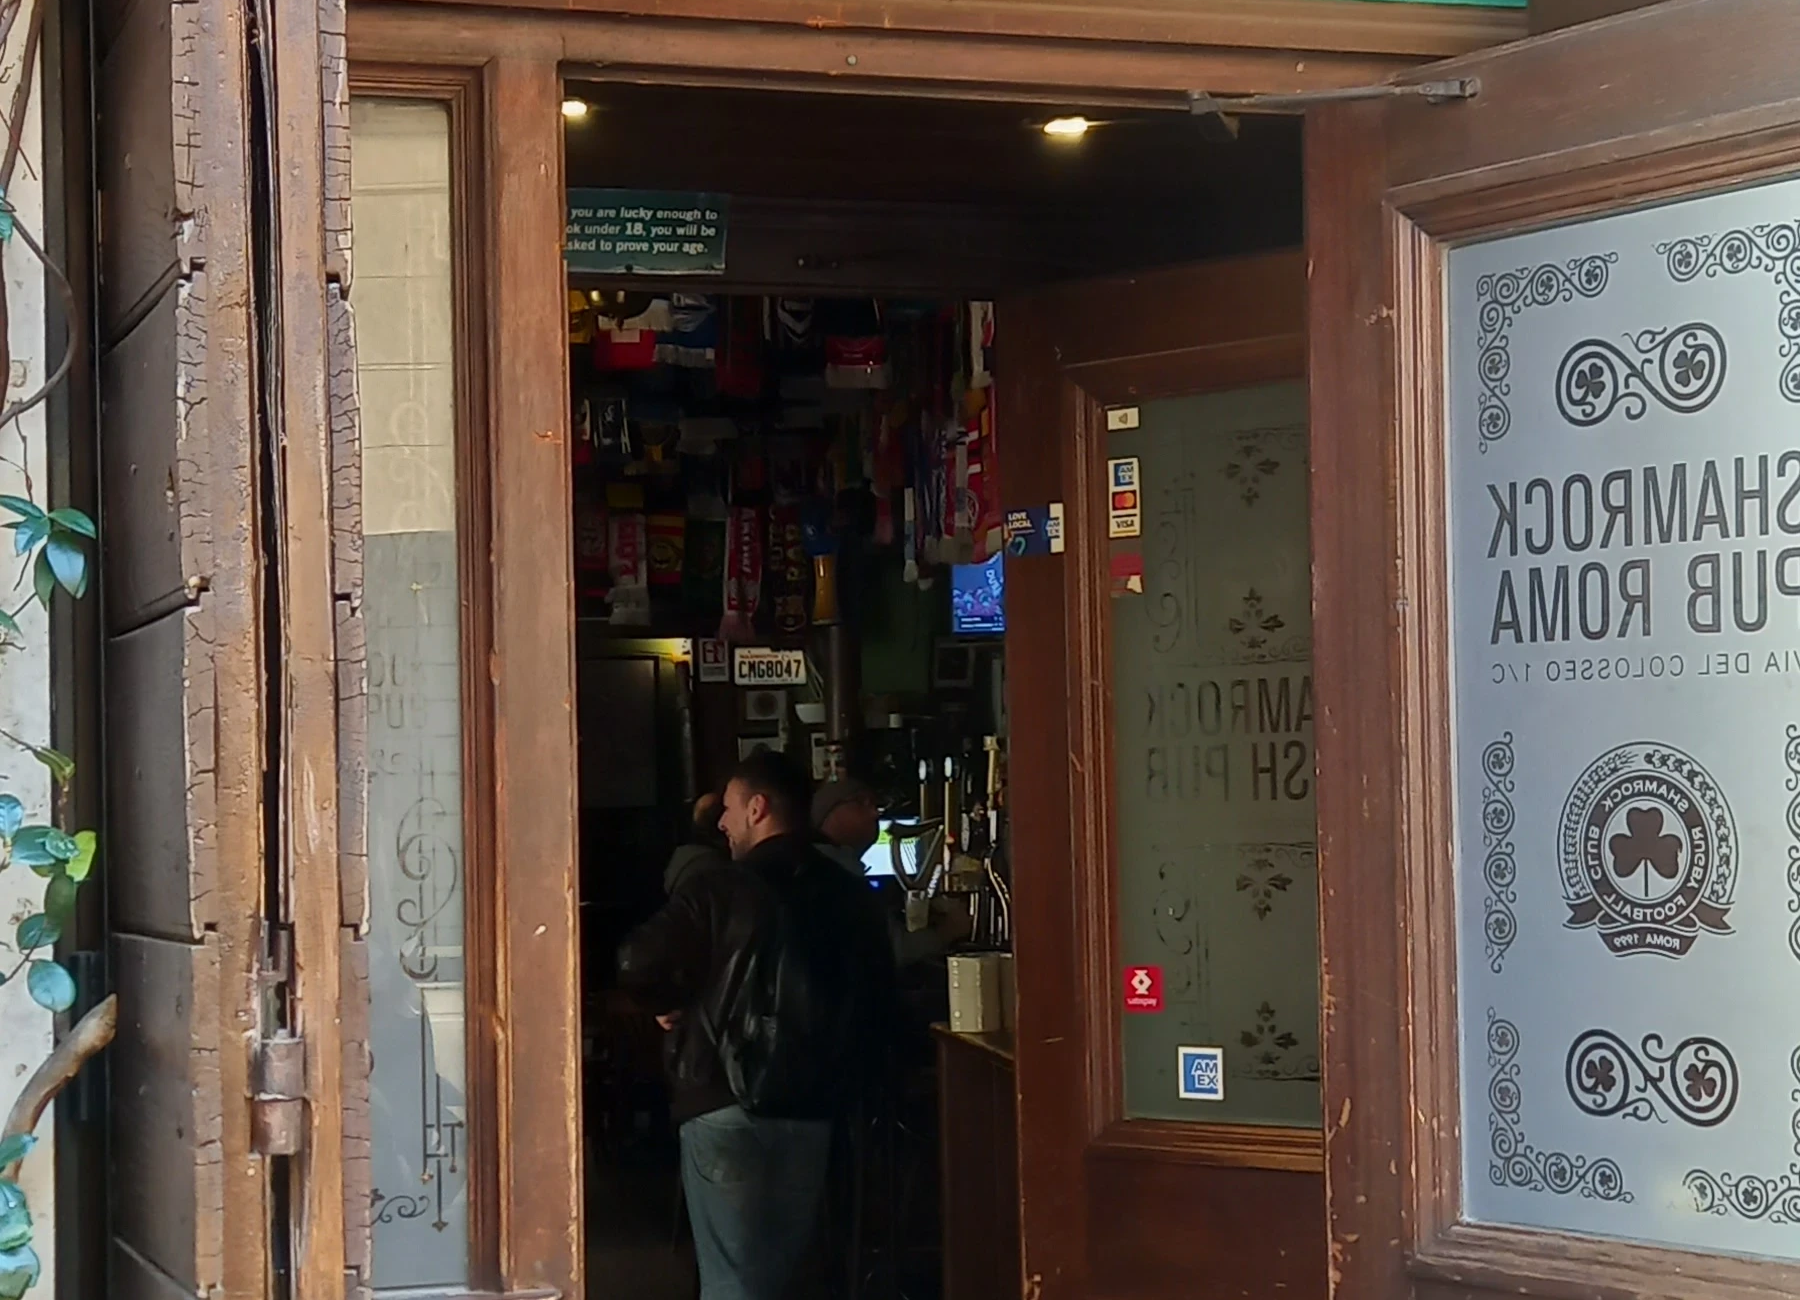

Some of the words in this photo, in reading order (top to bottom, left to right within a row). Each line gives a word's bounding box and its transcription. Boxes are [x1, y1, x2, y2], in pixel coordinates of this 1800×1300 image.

[571, 208, 593, 219] you
[597, 209, 616, 218] are
[620, 207, 653, 220] lucky
[656, 209, 700, 221] enough
[705, 210, 718, 219] to
[566, 223, 580, 235] ok
[584, 224, 620, 235] under
[625, 222, 646, 236] 18,
[650, 226, 672, 237] you
[676, 225, 697, 236] will
[700, 225, 716, 236] be
[564, 239, 596, 251] sked
[600, 240, 612, 251] to
[616, 241, 649, 253] prove
[652, 242, 679, 254] your
[682, 242, 708, 254] age.
[1008, 512, 1027, 521] LOVE
[1115, 519, 1135, 529] VISA
[738, 659, 802, 678] CMG8047
